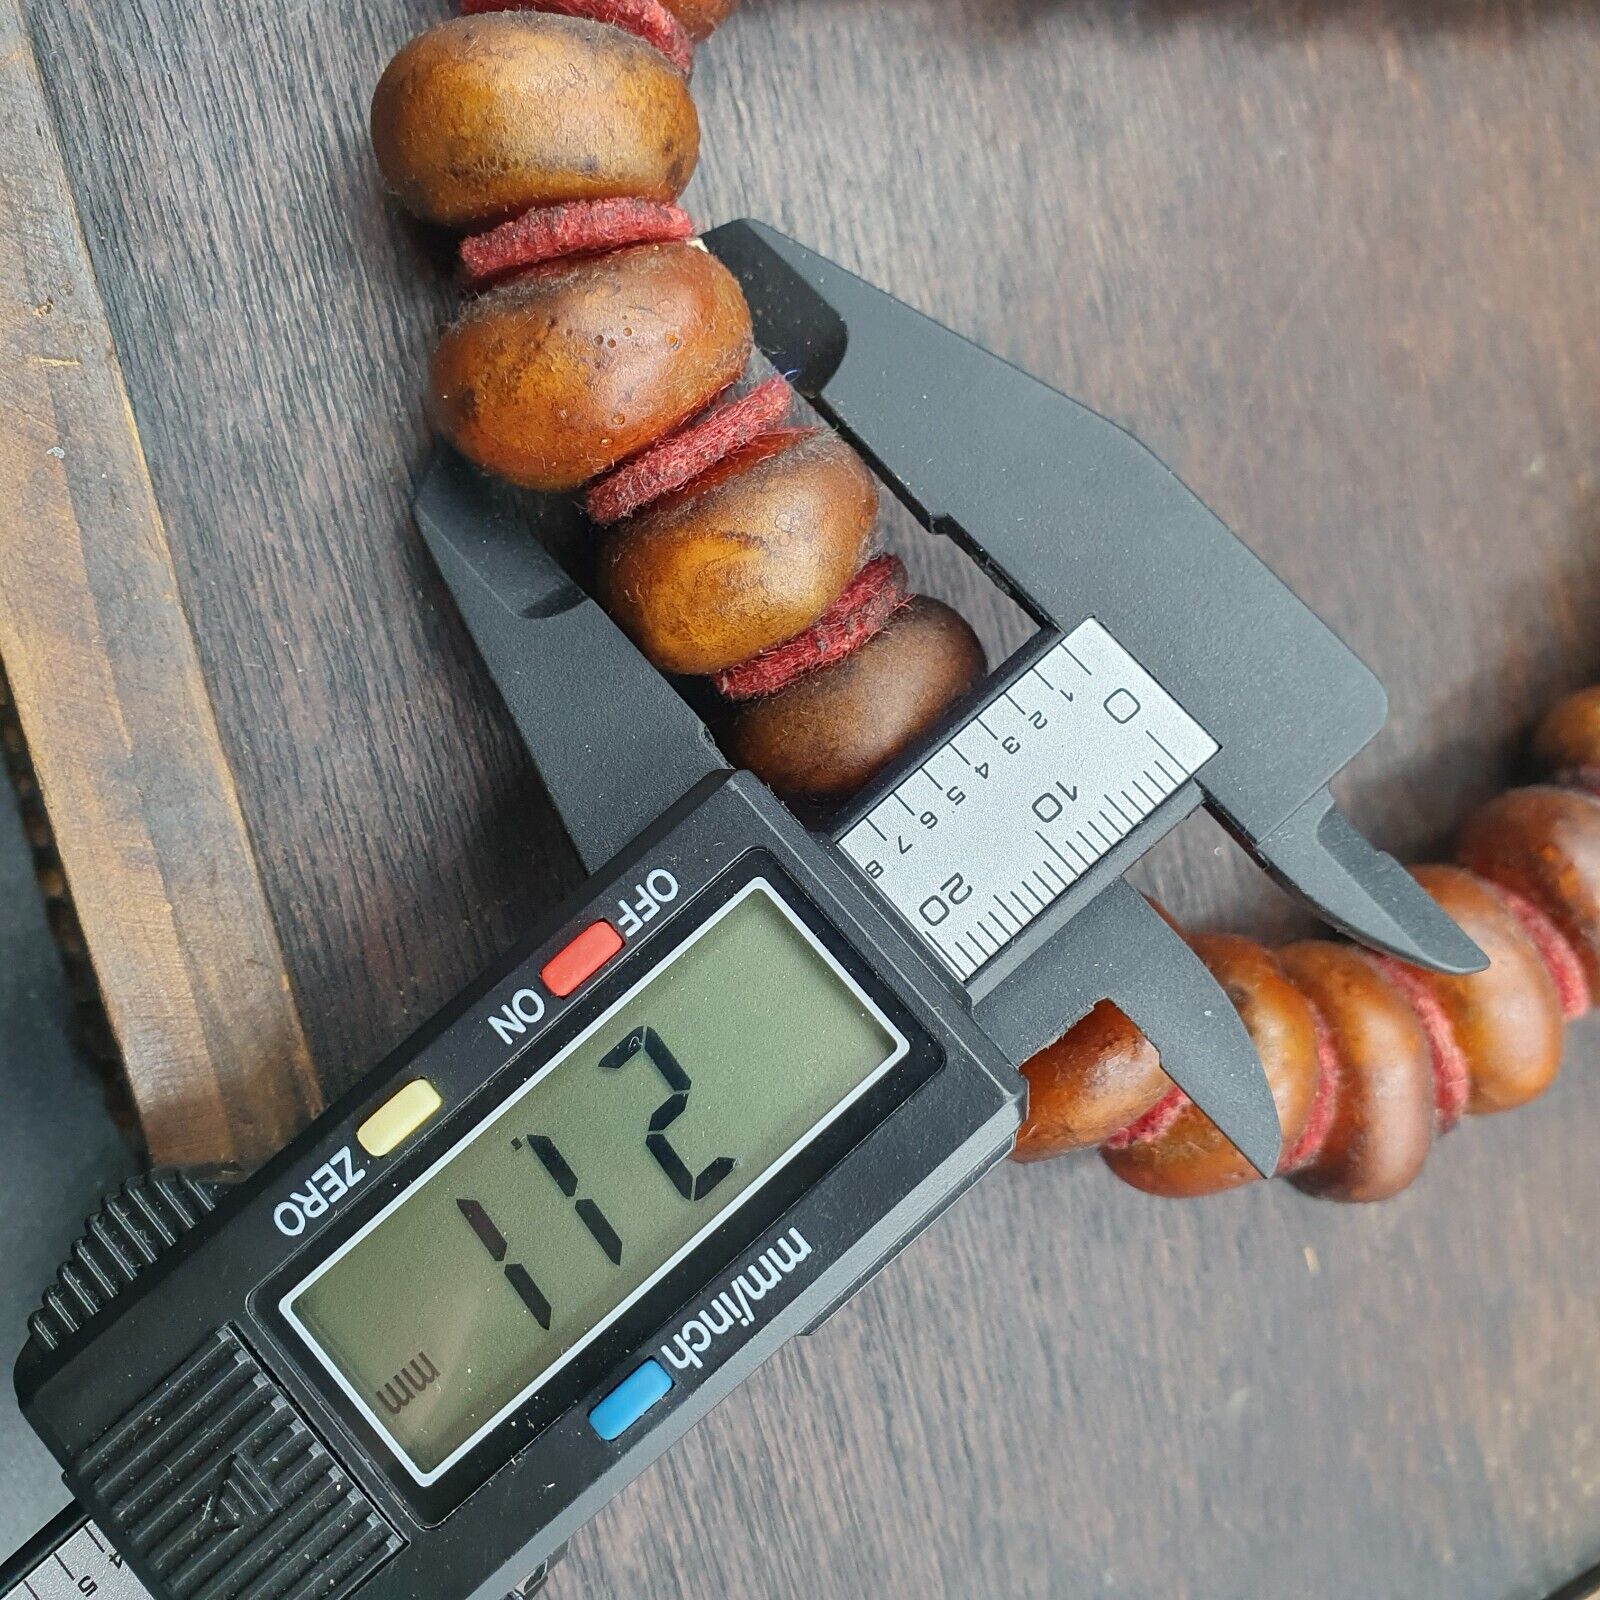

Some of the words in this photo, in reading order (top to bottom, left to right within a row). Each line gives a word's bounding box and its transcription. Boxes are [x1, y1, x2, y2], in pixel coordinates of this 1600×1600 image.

[1059, 687, 1074, 703] 1
[1103, 687, 1141, 724] 0
[1028, 710, 1048, 730] 2
[1001, 735, 1021, 755] 3
[974, 762, 990, 780] 4
[946, 785, 966, 806] 5
[1031, 780, 1079, 823] 10
[919, 810, 938, 830] 6
[896, 835, 913, 855] 7
[865, 860, 884, 879] 8
[617, 867, 680, 938] OFF
[918, 872, 973, 926] 20
[487, 988, 546, 1045] ON
[272, 1145, 367, 1237] ZERO
[660, 1226, 813, 1370] mm/inch
[374, 1350, 442, 1415] mm
[108, 1552, 123, 1569] 4
[77, 1575, 99, 1597] 5
